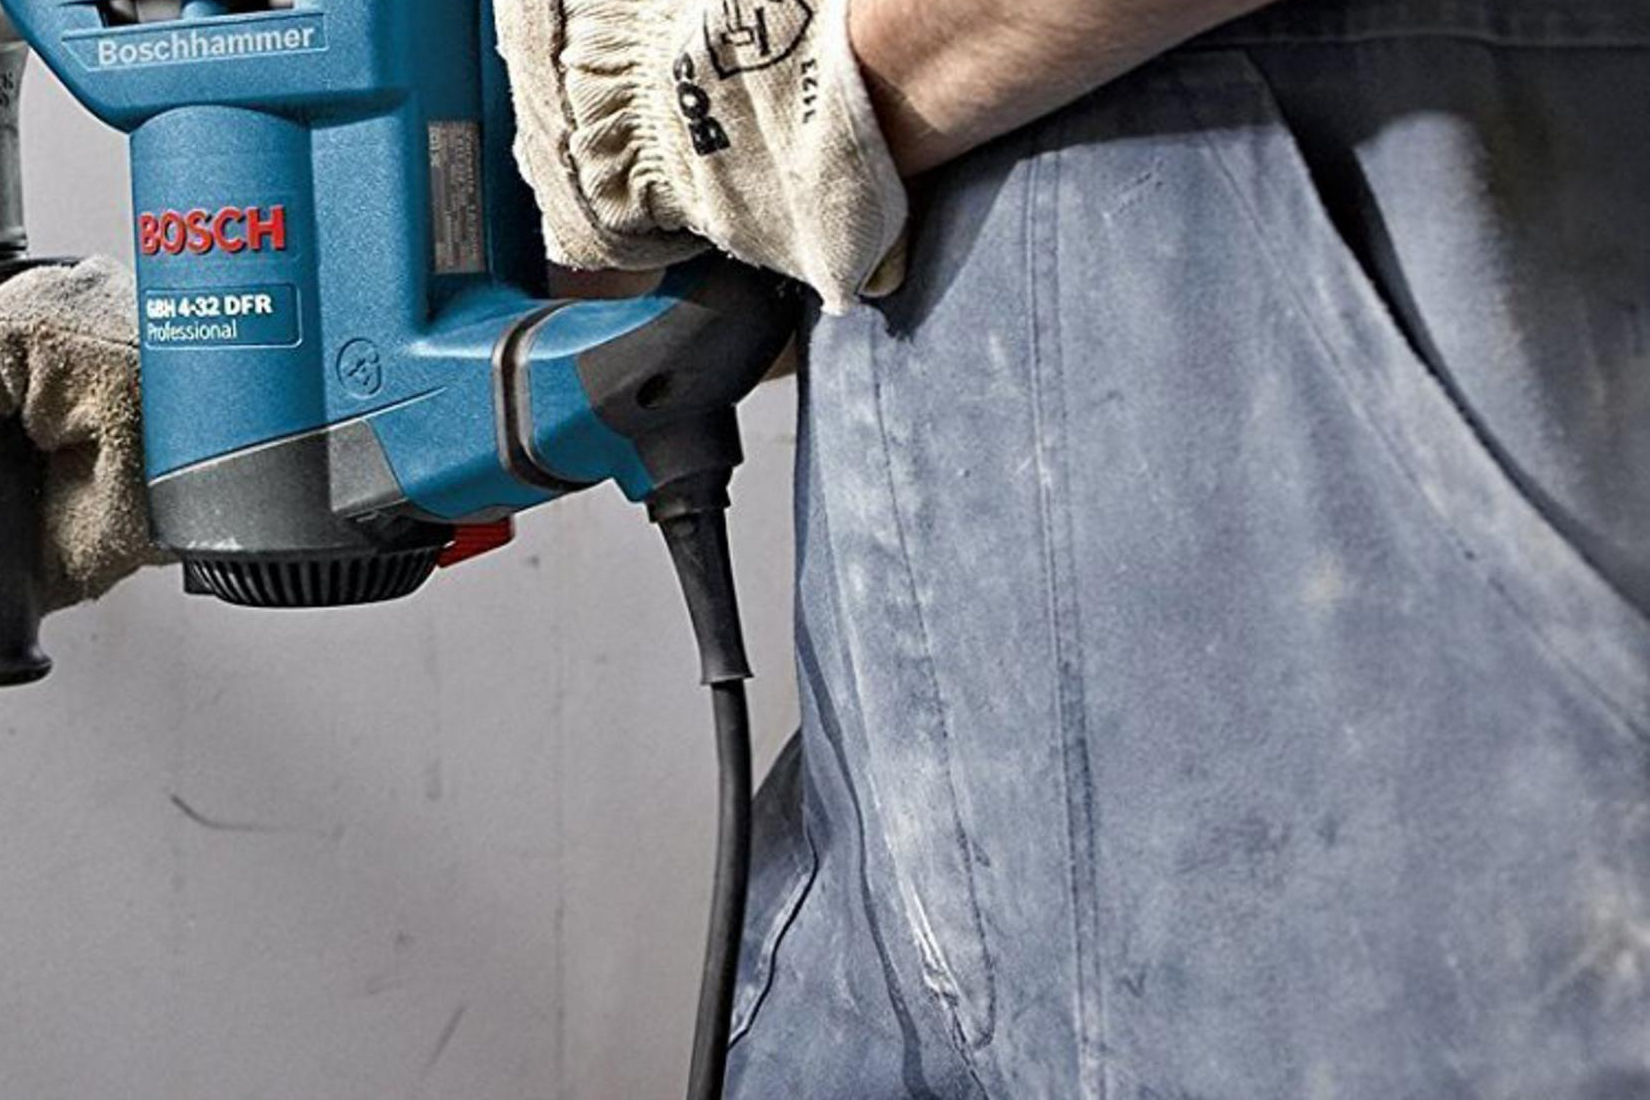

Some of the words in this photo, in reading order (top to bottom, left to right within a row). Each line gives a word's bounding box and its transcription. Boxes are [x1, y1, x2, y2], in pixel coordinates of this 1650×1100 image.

[98, 26, 315, 66] Boschhammer
[138, 204, 286, 255] BOSCH
[178, 295, 221, 317] 4-32
[223, 293, 274, 316] DFR
[146, 318, 238, 342] Professional
